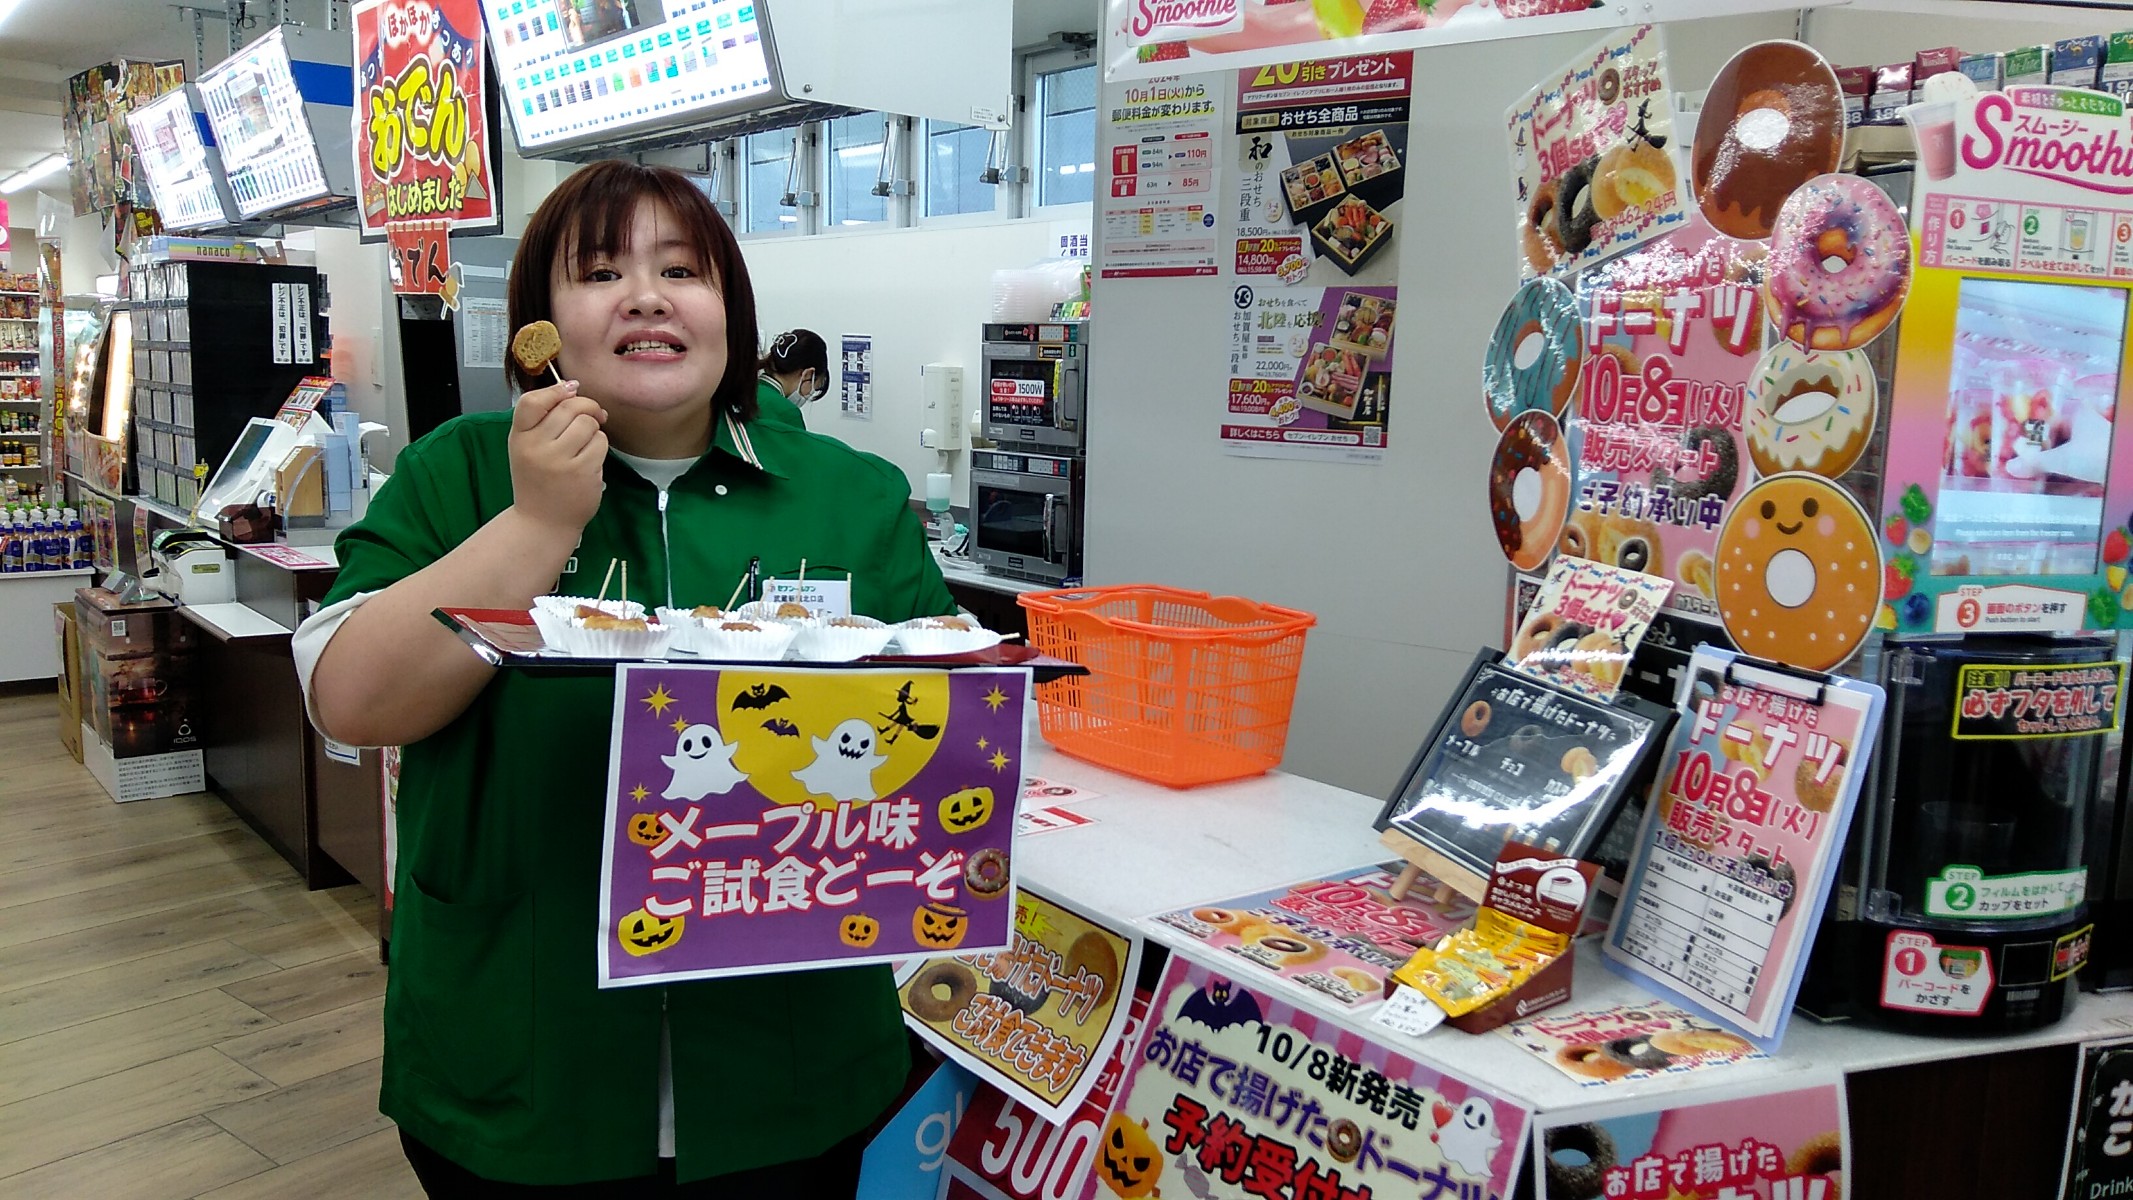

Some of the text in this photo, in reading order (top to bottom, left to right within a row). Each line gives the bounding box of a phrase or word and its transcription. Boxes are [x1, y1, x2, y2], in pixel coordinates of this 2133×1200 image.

[388, 3, 431, 37] ほかほか
[2057, 39, 2094, 53] CAMEL
[1328, 57, 1396, 80] プレゼント
[1623, 61, 1658, 80] スタッフ
[2086, 57, 2095, 65] 6
[1125, 84, 1205, 103] 10月1日(火)から
[1622, 78, 1662, 99] おすすめ
[371, 64, 466, 174] おでん
[1112, 100, 1215, 122] 郵便料金が変わります。
[1280, 105, 1359, 126] おせち全商品
[2014, 114, 2088, 137] スムージー
[1187, 149, 1207, 158] 110円
[1182, 177, 1199, 187] 85円
[387, 175, 463, 218] はじめました
[196, 245, 231, 258] nanaco
[1924, 216, 1941, 264] 作り方
[1944, 255, 2011, 268] バーコードを読み取る
[1588, 285, 1758, 356] ドーナツ
[1018, 383, 1043, 395] 1500W
[1581, 354, 1747, 431] 10月8日(火)
[1229, 427, 1280, 439] 詳しくはこちら
[1581, 426, 1721, 480] 販売スタート
[1579, 480, 1726, 531] ご予約承り中
[1563, 572, 1624, 605] ドーナツ
[1960, 588, 1983, 597] STEP
[1553, 595, 1613, 628] 3個set
[1986, 602, 2068, 615] 画面のボタンを押す
[1722, 685, 1819, 728] お店で揚げた
[1962, 684, 2118, 719] 必ずフタを外して
[1690, 699, 1843, 786] ドーナツ
[1668, 749, 1821, 841] 10月8日(火)
[648, 797, 921, 861] メープル味
[1667, 800, 1786, 870] 販売スタート
[644, 850, 966, 918] ご試食どーぞ
[1949, 870, 1977, 881] STEP
[1979, 898, 2049, 912] カップをセット
[1898, 936, 1929, 947] STEP
[1898, 979, 1972, 995] バーコードを
[1916, 992, 1953, 1006] かざす
[952, 993, 1087, 1093] ご試食できます
[1144, 1026, 1332, 1148] お店で揚げた
[1256, 1024, 1425, 1131] 10/8新発売
[1606, 1141, 1777, 1198] お店で揚げた
